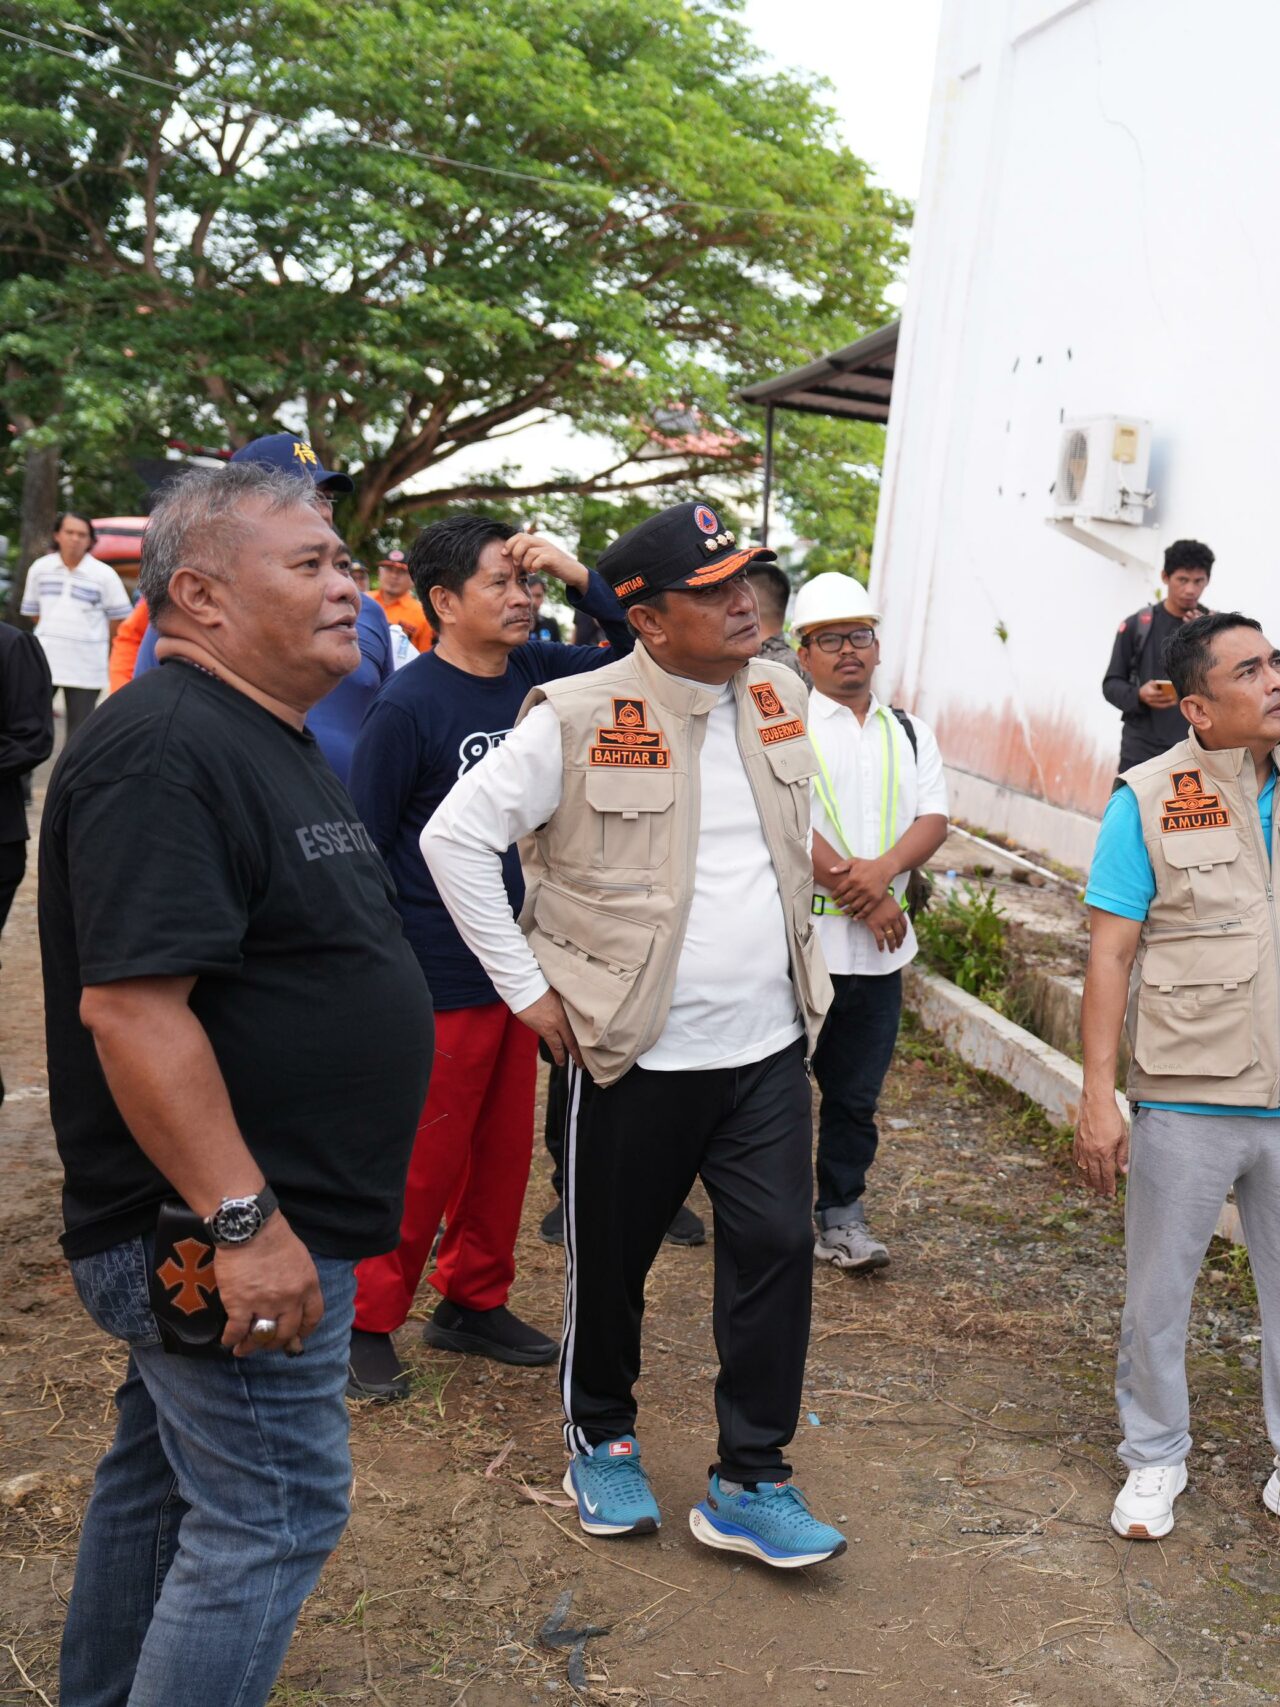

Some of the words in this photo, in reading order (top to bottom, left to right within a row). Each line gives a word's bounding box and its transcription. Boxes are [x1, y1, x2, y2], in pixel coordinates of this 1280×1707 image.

[761, 721, 804, 742] GUBERNUR
[594, 750, 649, 764] BAHTIAR
[656, 751, 665, 764] B
[1168, 813, 1225, 830] AMUJIB
